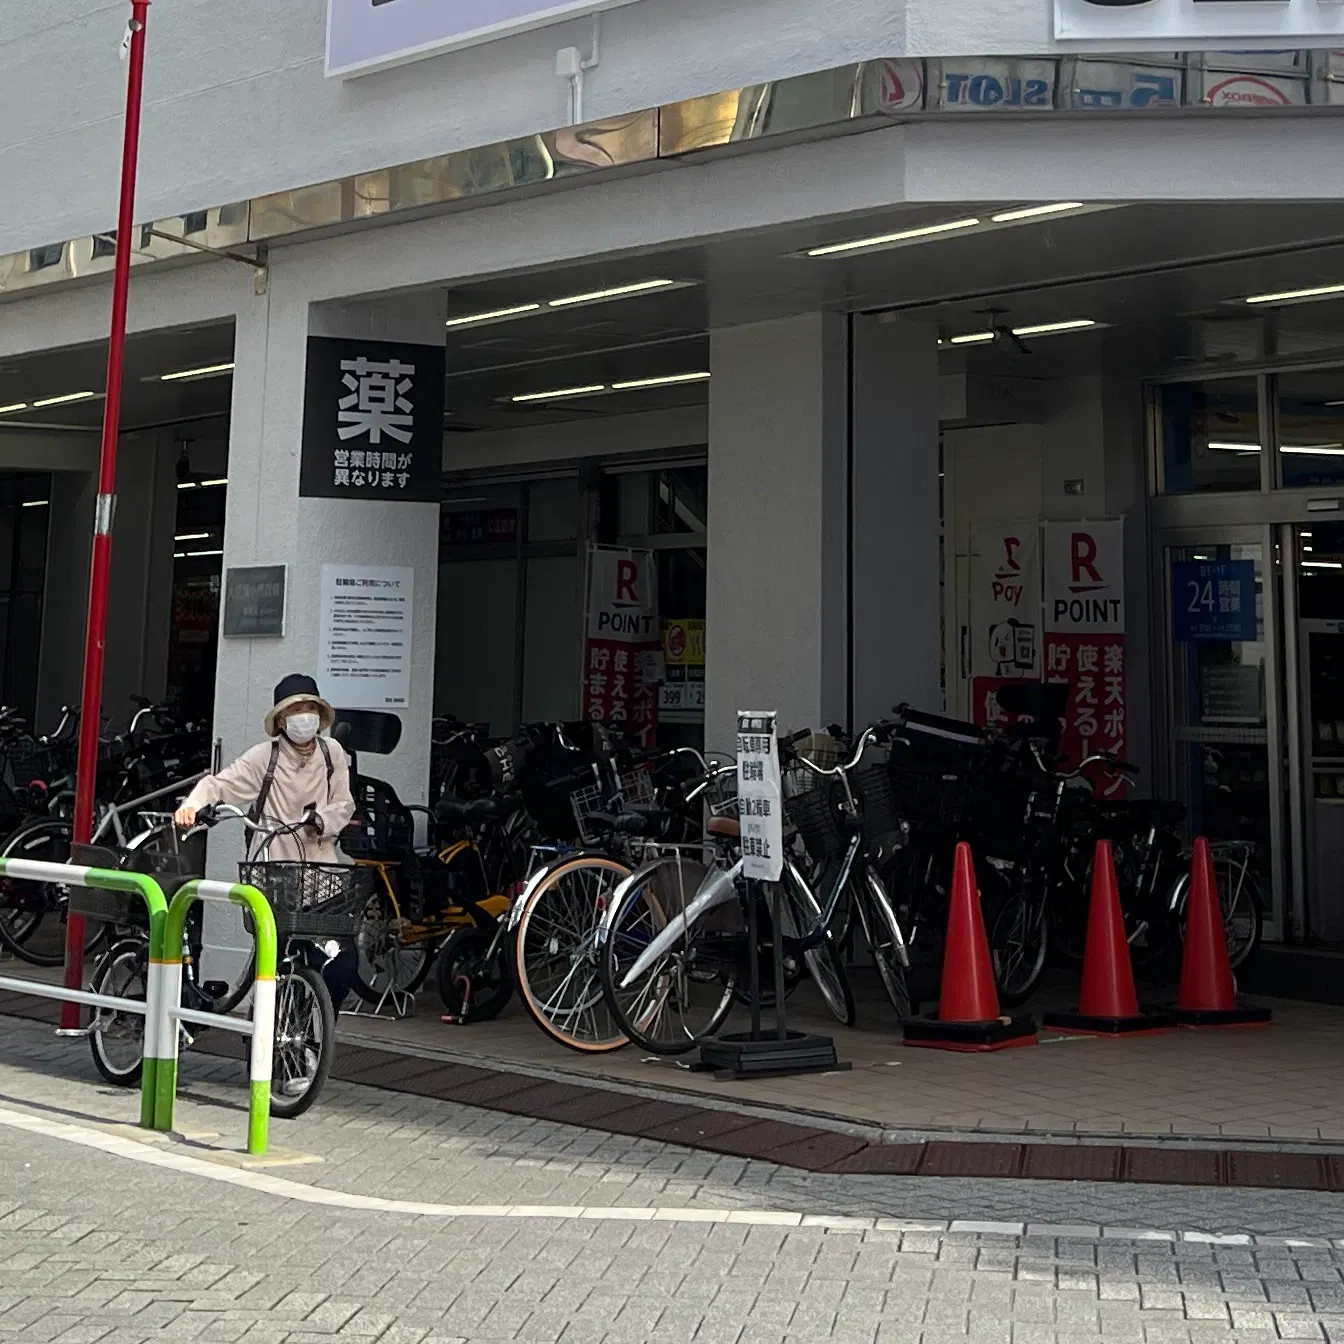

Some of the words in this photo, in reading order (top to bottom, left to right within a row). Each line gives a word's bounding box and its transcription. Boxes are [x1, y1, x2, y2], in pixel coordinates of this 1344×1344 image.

[335, 356, 416, 445] 薬
[333, 448, 413, 471] 営業時間が
[333, 469, 411, 489] 異なります
[1071, 532, 1104, 582] R
[616, 559, 639, 602] R
[1187, 579, 1216, 613] 24
[598, 611, 655, 634] POINT
[1054, 599, 1121, 623] POINT
